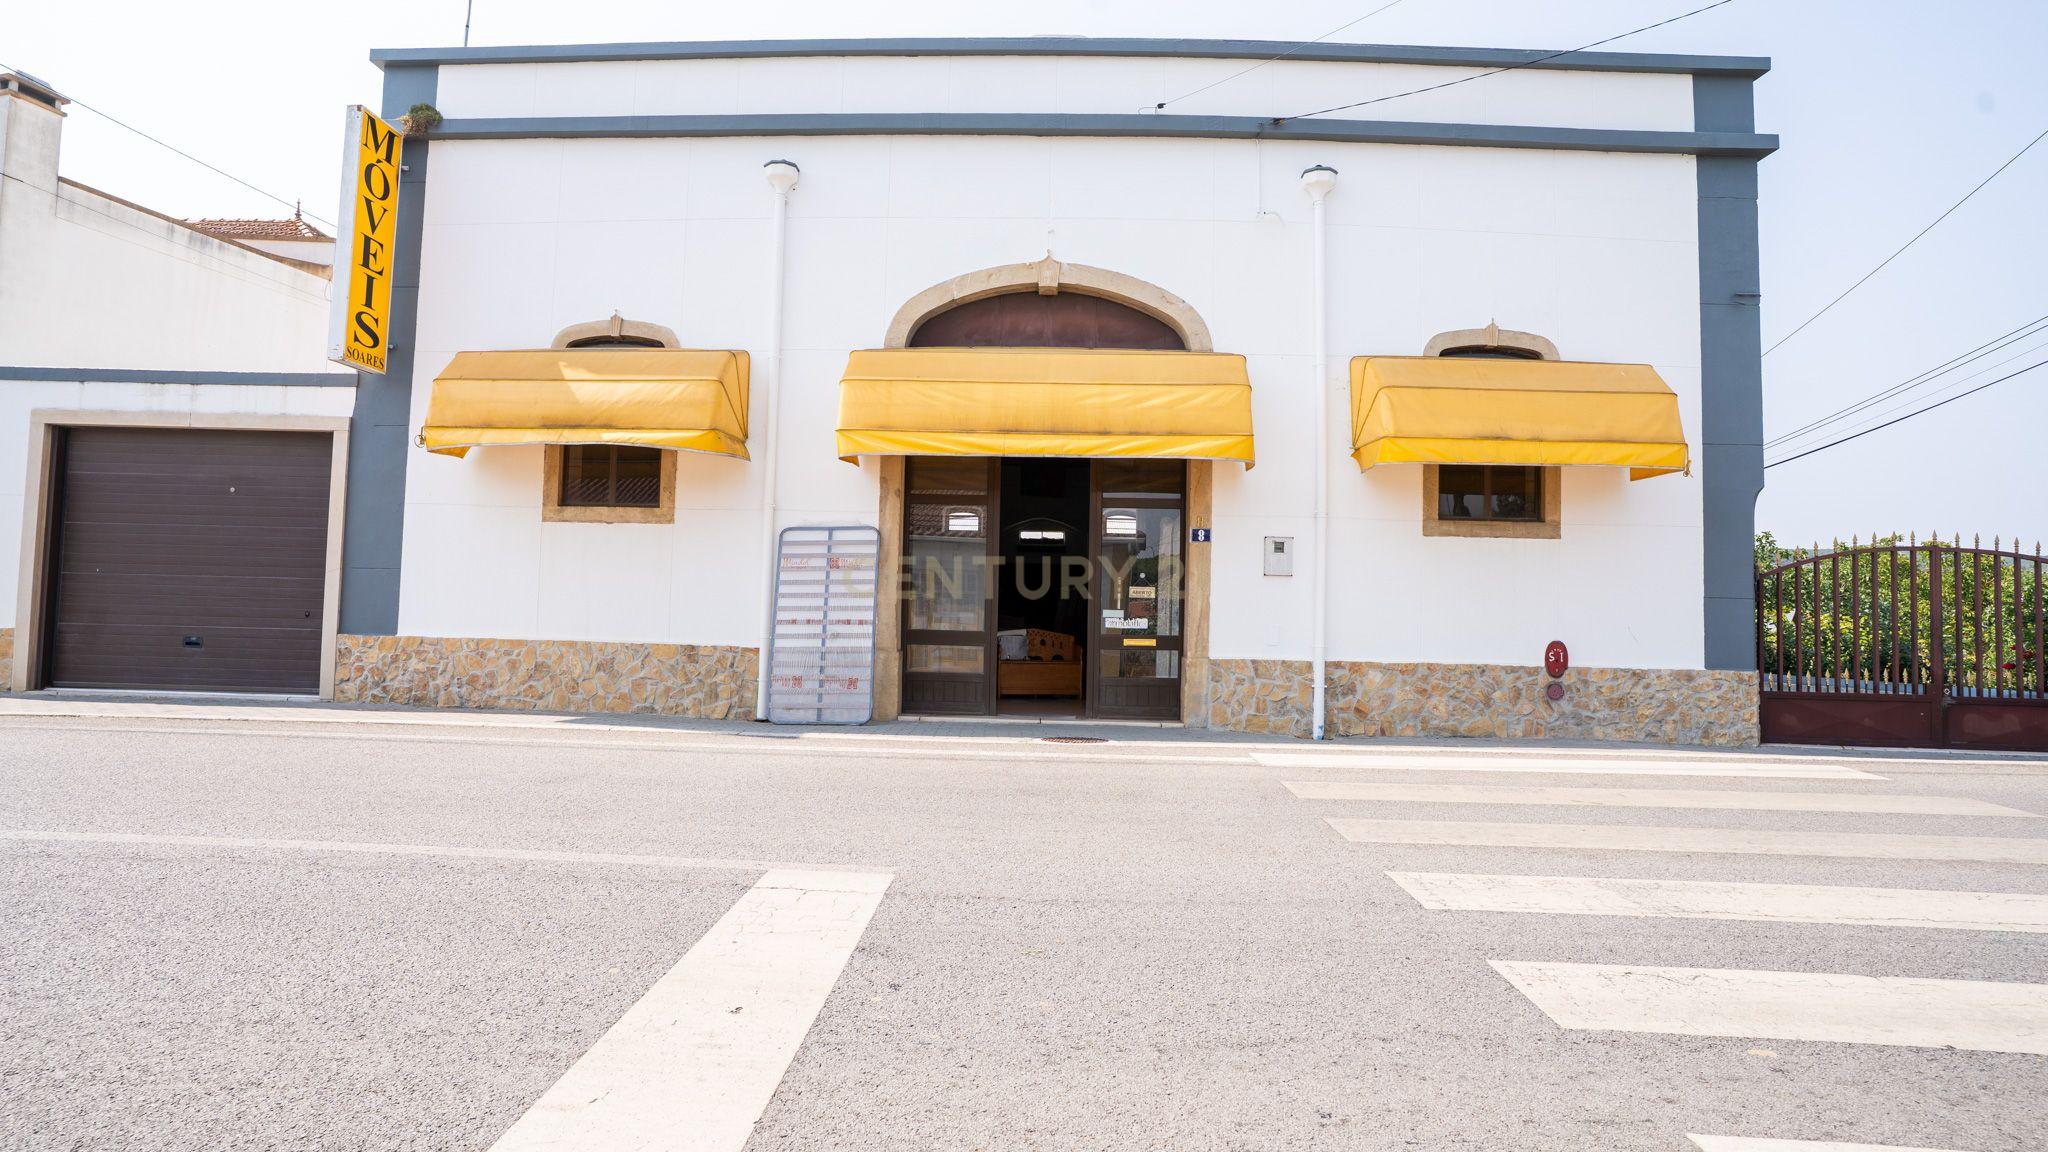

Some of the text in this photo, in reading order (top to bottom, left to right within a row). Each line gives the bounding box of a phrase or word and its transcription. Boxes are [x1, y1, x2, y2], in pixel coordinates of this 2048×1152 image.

[353, 111, 399, 350] MÓVEIS
[346, 345, 385, 370] SOARES
[1197, 529, 1205, 541] 8
